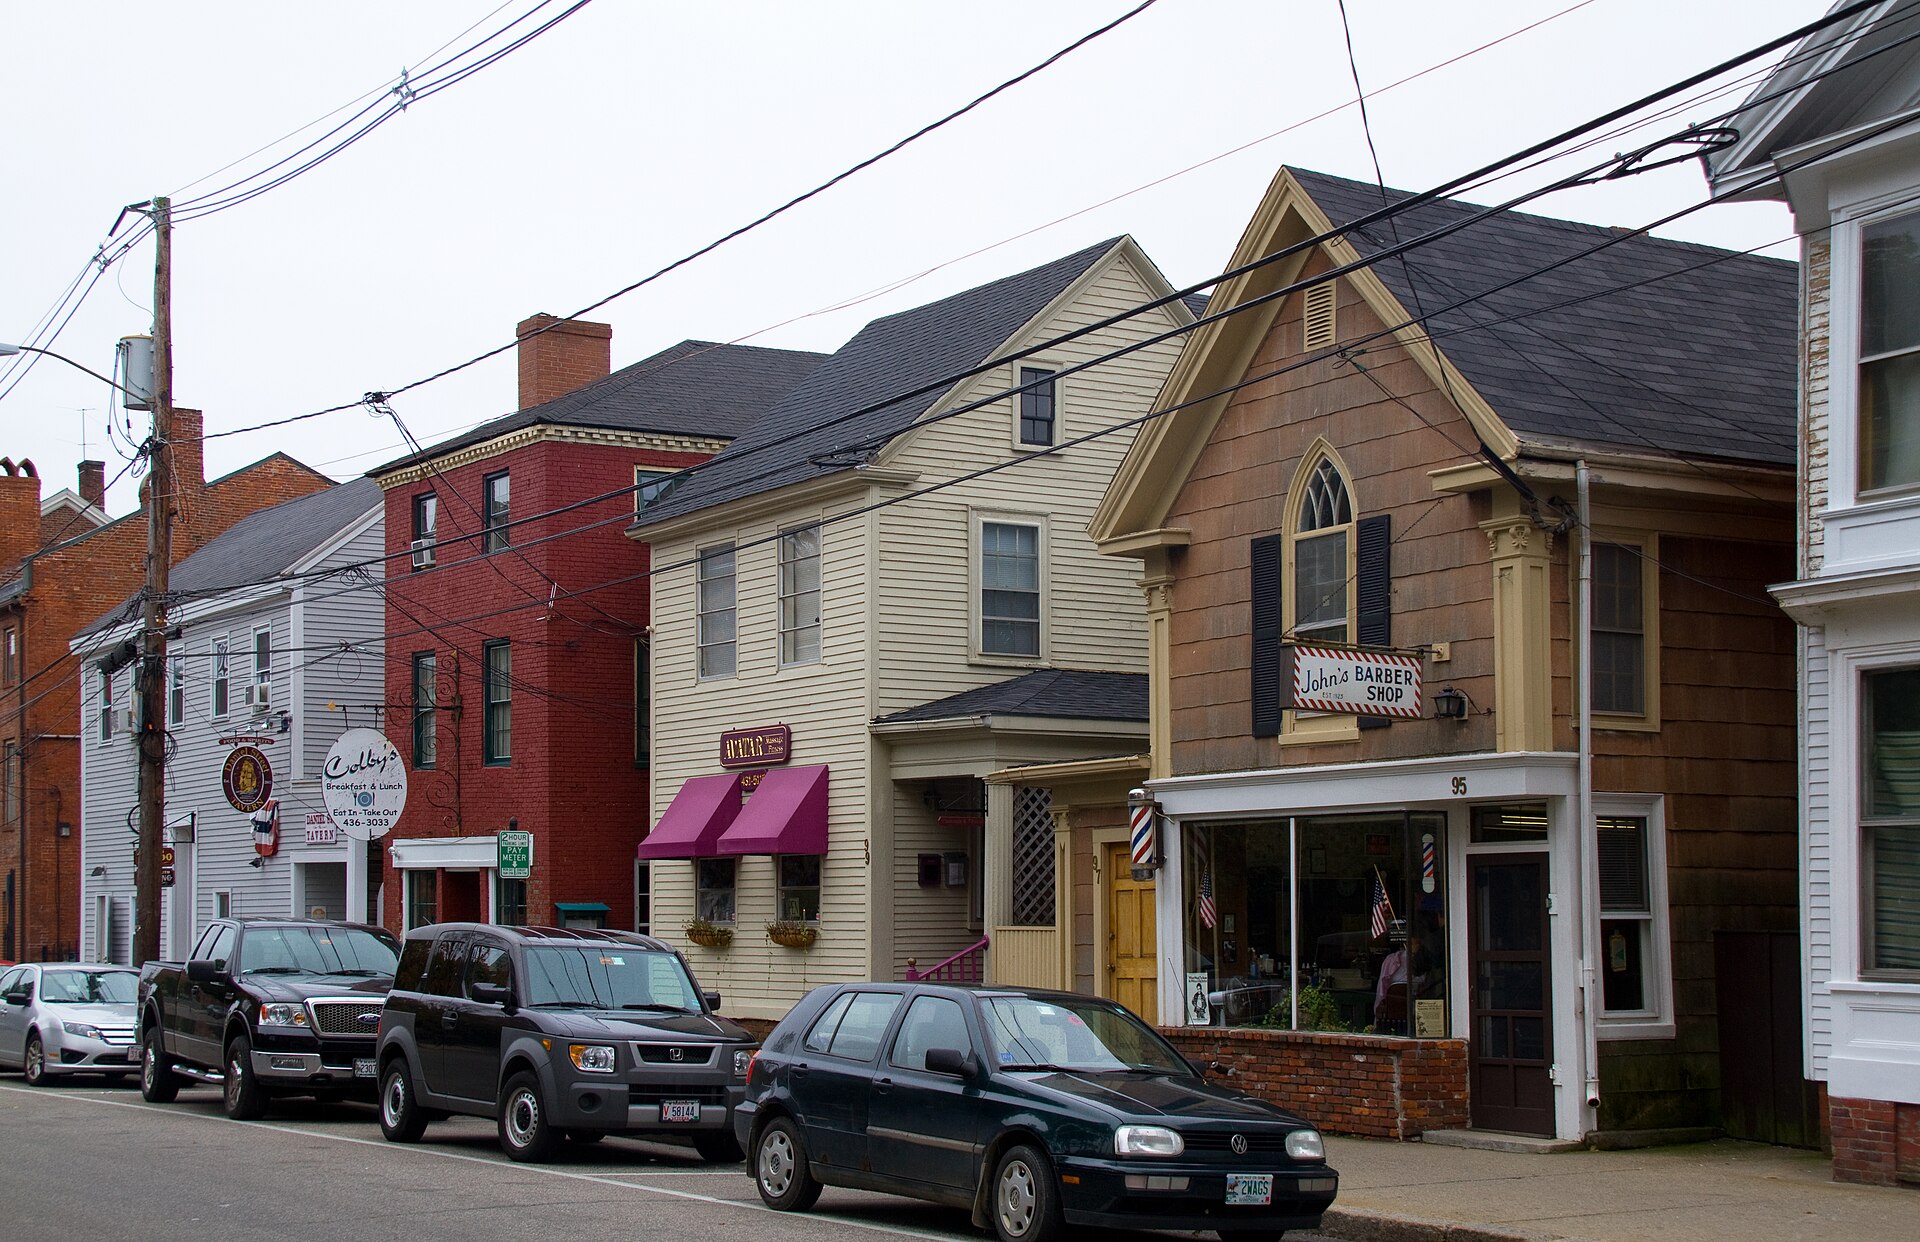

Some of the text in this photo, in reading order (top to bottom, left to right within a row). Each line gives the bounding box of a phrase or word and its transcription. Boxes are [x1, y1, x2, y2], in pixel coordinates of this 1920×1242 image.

[1301, 665, 1413, 694] John's BARBER
[1367, 686, 1404, 703] SHOP
[723, 735, 784, 759] AVATAR Massage
[768, 745, 784, 753] Fitness
[224, 747, 270, 773] Daniel Street
[324, 744, 399, 778] Colby's
[326, 782, 367, 791] Breakfast
[379, 782, 403, 791] Lunch
[1452, 776, 1467, 796] 95
[231, 796, 264, 812] TAVERN
[306, 814, 325, 824] DANIEL
[343, 818, 389, 827] 436-3033
[306, 829, 334, 841] TAVERN
[502, 833, 508, 841] 2
[1092, 855, 1101, 885] 97
[664, 1105, 694, 1117] V 58144
[1241, 1180, 1269, 1195] 2WAGS
